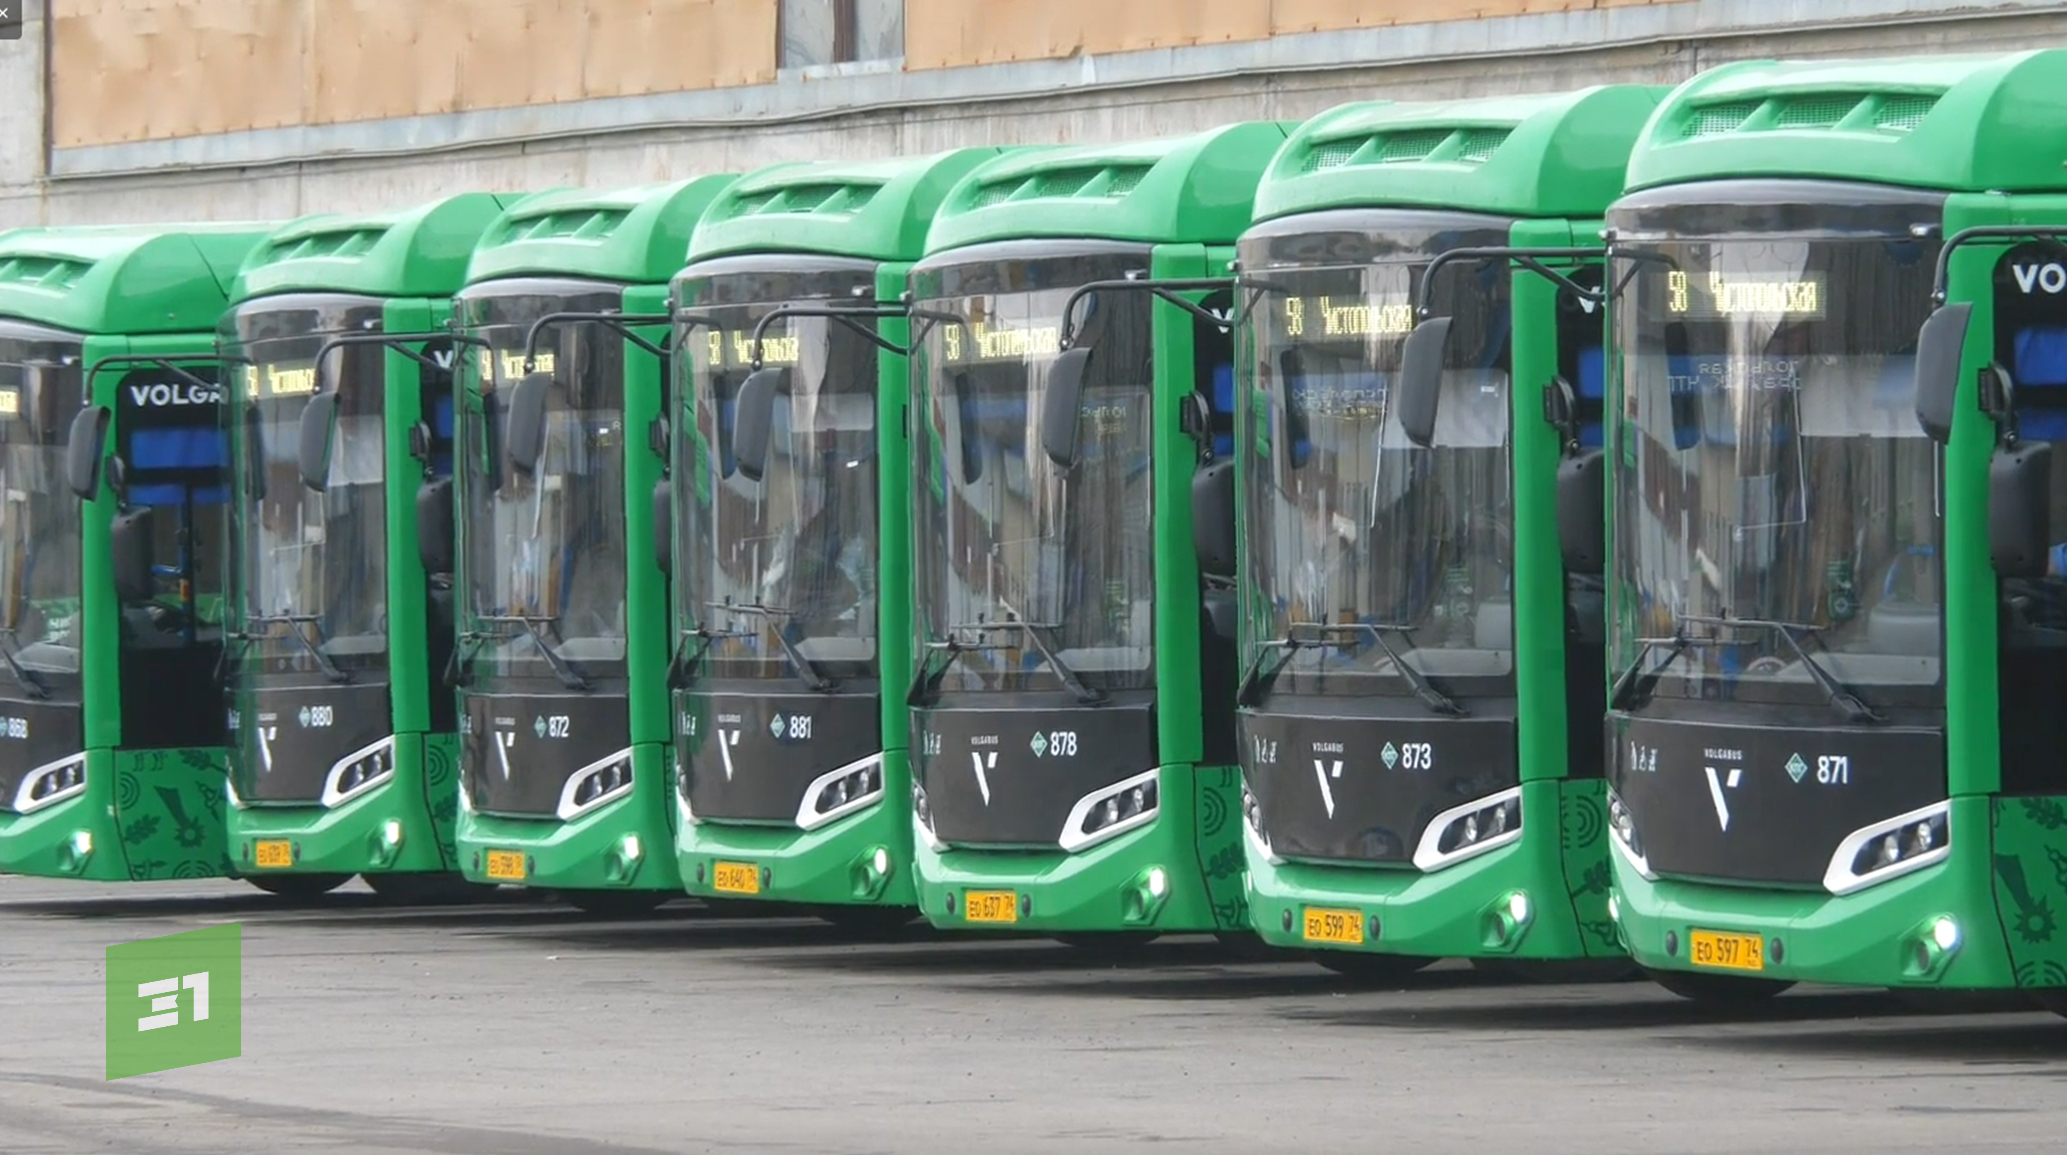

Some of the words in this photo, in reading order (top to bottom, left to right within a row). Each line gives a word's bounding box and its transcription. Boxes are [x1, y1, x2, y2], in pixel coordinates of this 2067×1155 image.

[1668, 271, 1688, 312] 58
[1286, 297, 1303, 335] 58
[945, 324, 960, 360] 58
[311, 705, 333, 727] 880
[548, 715, 570, 738] 872
[789, 715, 812, 739] 881
[1050, 731, 1077, 756] 878
[1402, 743, 1432, 770] 873
[1817, 755, 1848, 784] 871
[1325, 914, 1345, 939] 599
[1717, 937, 1739, 964] 597
